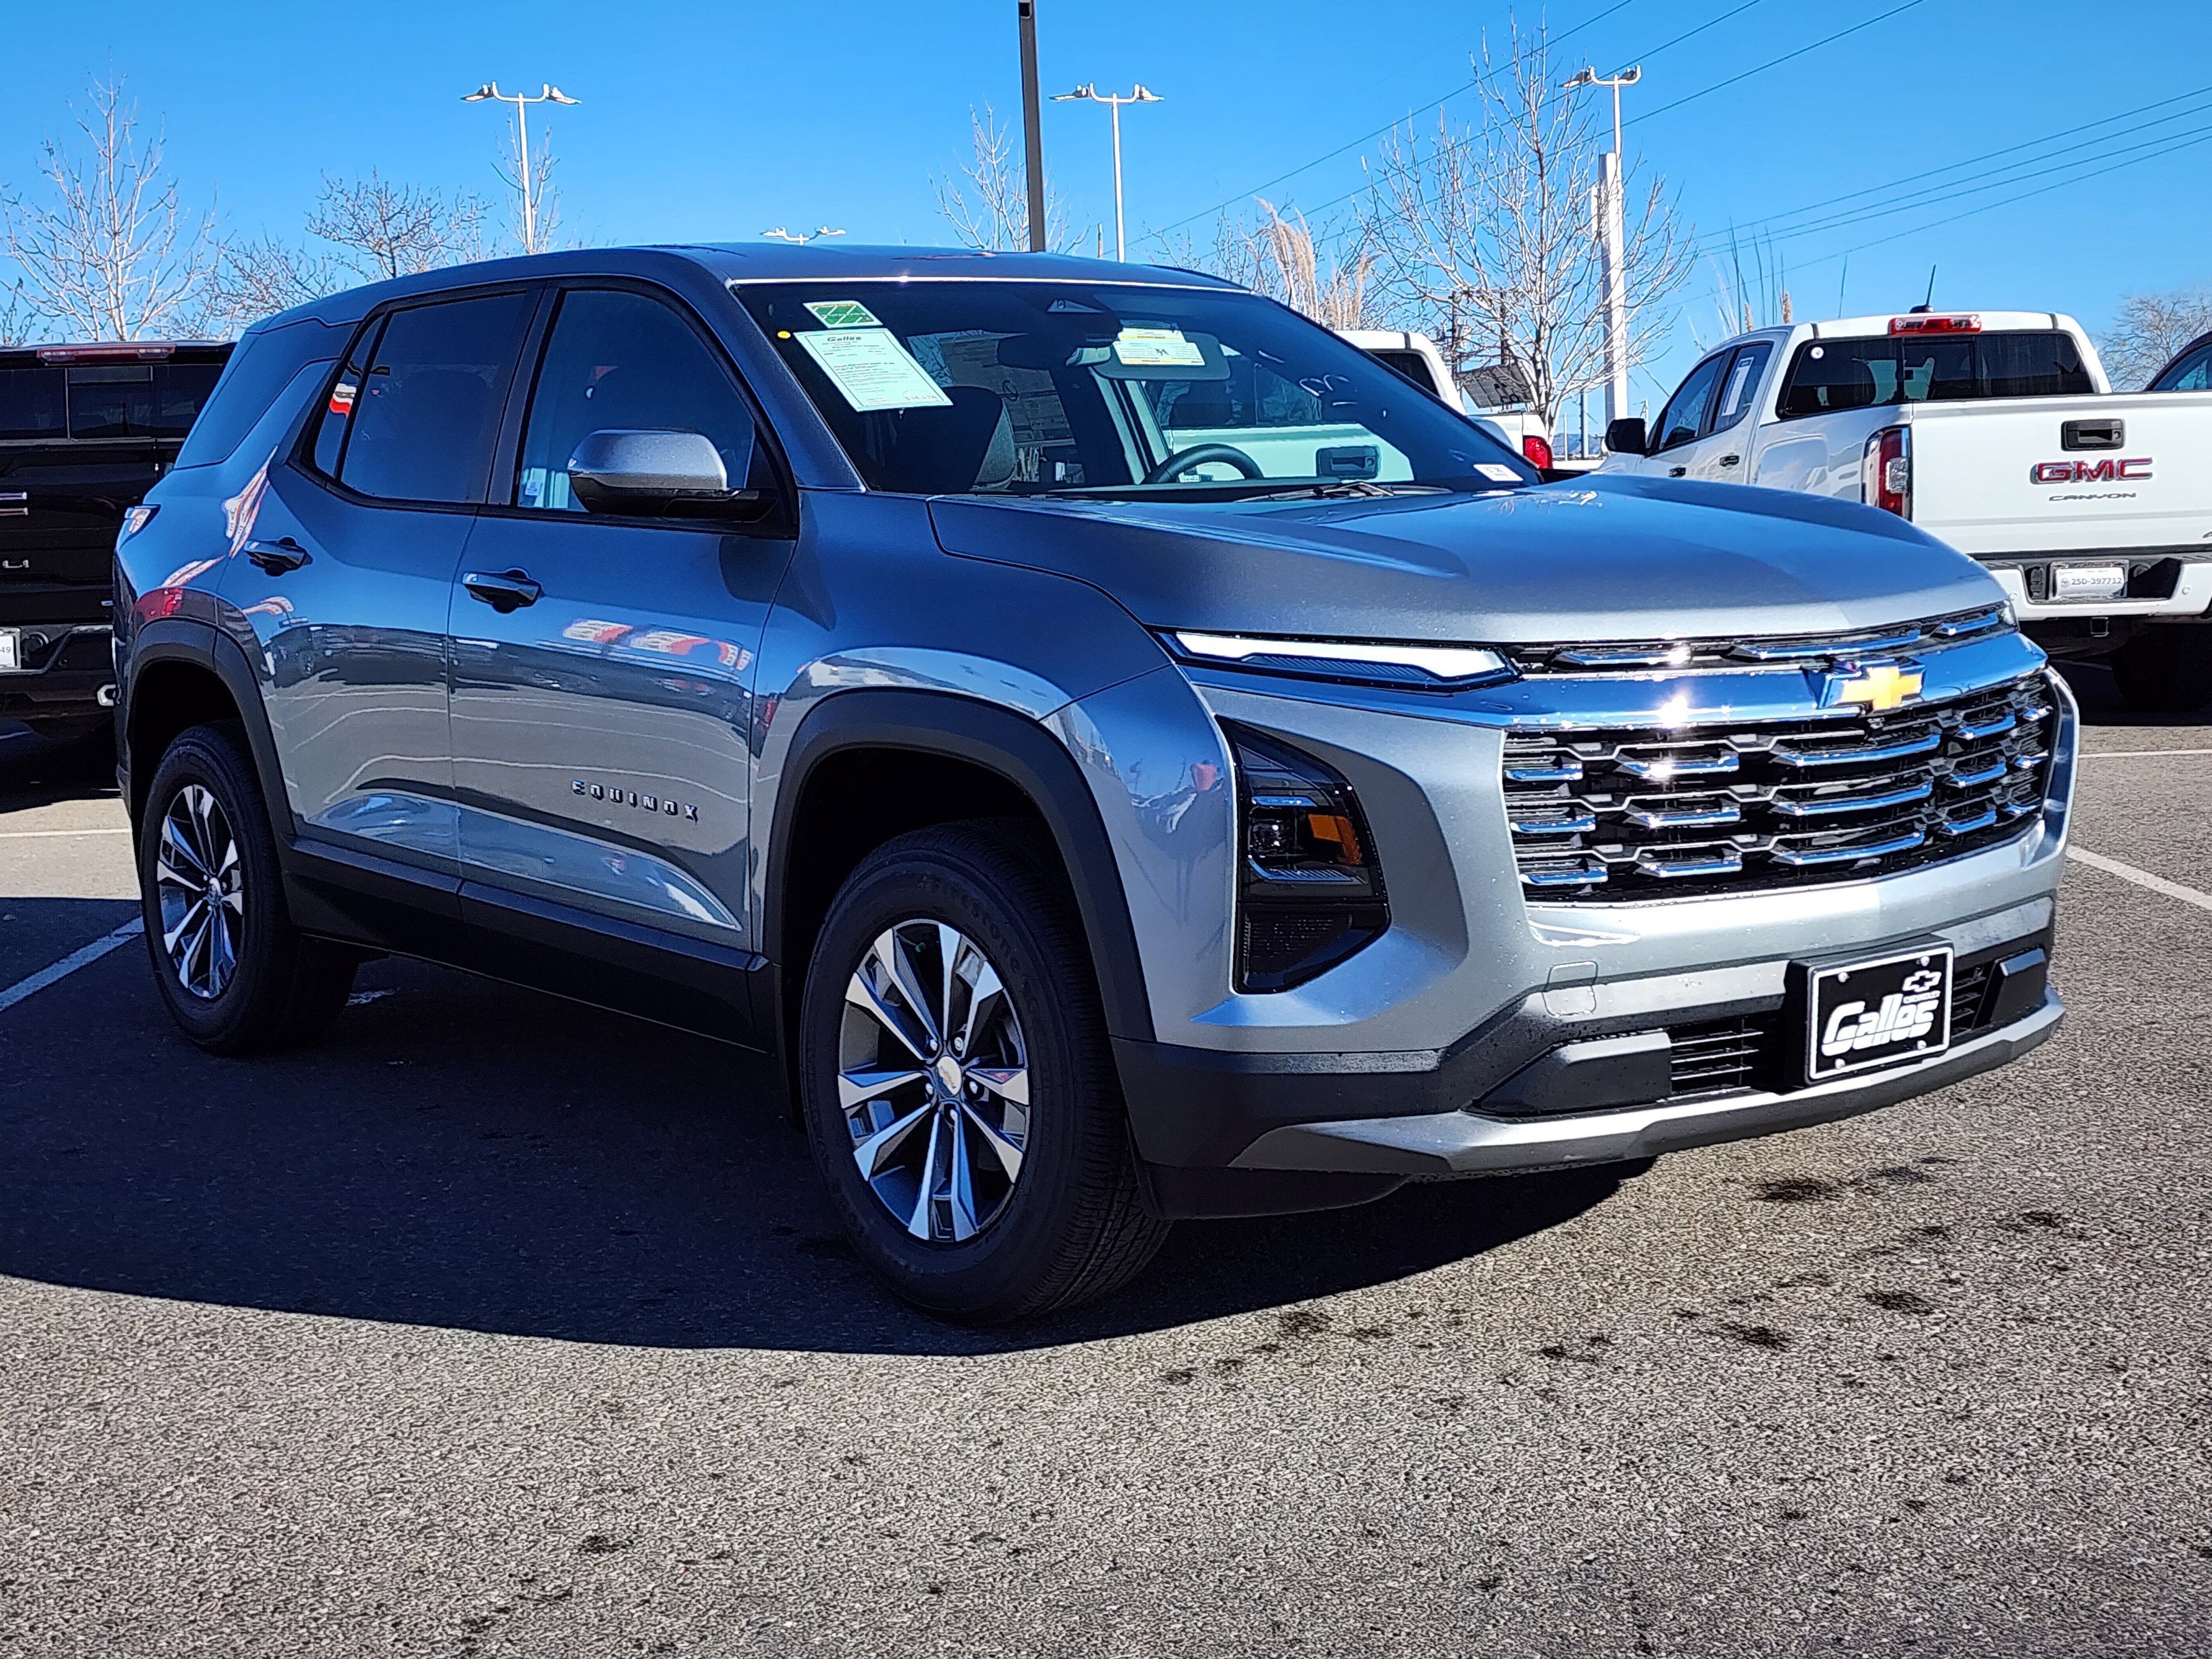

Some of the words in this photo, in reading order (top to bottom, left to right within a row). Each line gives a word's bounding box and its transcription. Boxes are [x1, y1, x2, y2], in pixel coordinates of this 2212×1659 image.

[2030, 457, 2153, 485] GMC
[2048, 493, 2137, 502] CANYON
[571, 779, 698, 824] EQUINOX
